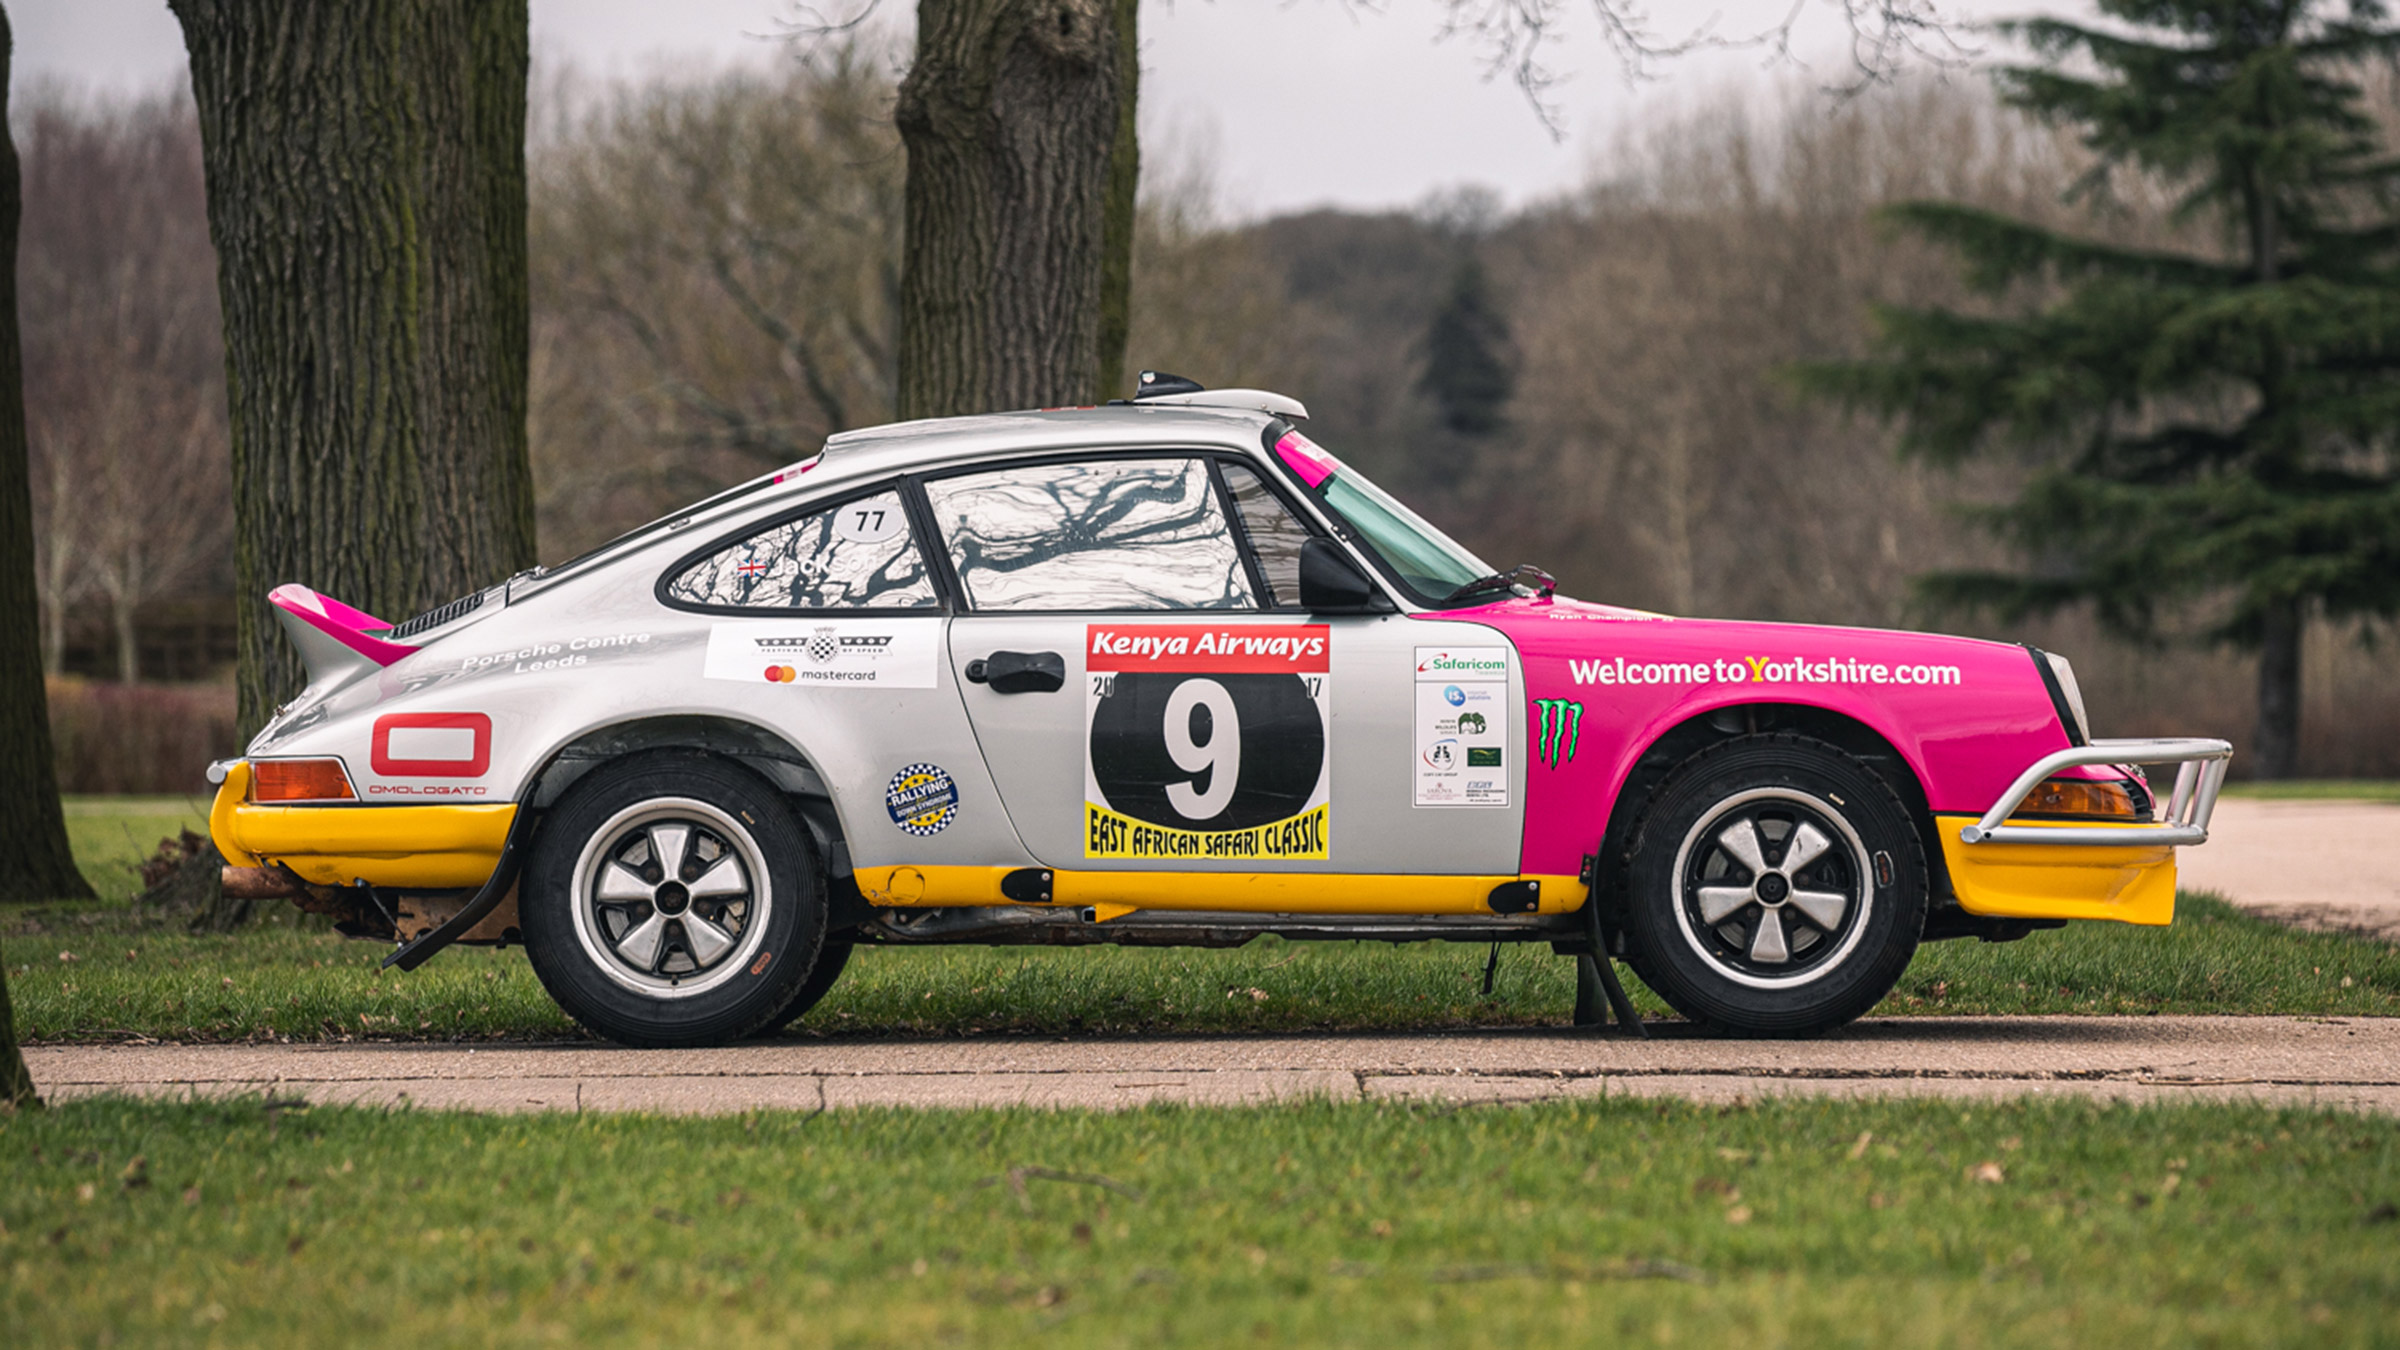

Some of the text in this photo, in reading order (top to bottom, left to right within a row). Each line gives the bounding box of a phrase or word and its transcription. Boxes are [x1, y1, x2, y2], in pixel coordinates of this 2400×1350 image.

[855, 511, 885, 532] 77
[771, 554, 877, 577] Jackson
[1587, 614, 1653, 622] Champion
[461, 632, 651, 671] Porsche Centre
[1092, 632, 1325, 661] Kenya Airways
[513, 652, 588, 674] Leeds
[1433, 658, 1505, 670] Safaricom
[802, 670, 877, 682] mastercard
[1163, 678, 1241, 821] 9
[368, 785, 487, 795] OMOLOGATO
[891, 778, 949, 807] RALLYING
[896, 793, 953, 818] DOWN SYNDROME
[1090, 809, 1324, 857] EAST AFRICAN SAFARI CLASSIC
